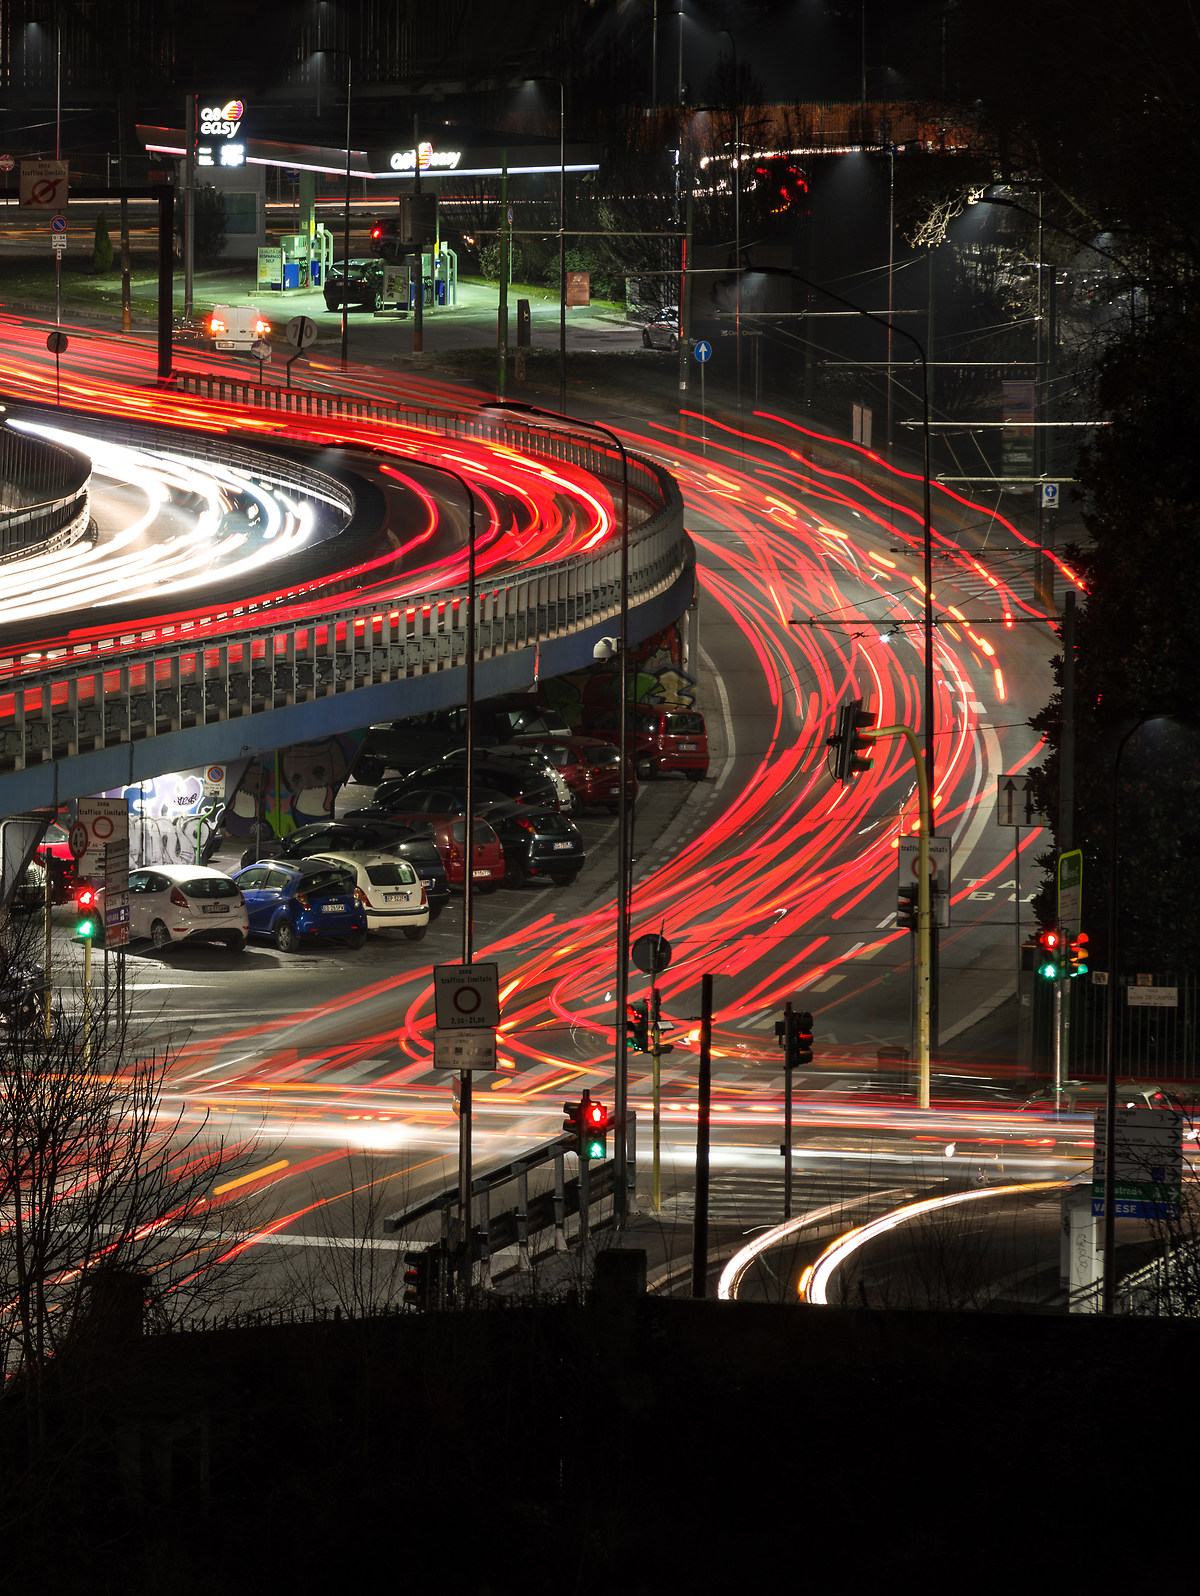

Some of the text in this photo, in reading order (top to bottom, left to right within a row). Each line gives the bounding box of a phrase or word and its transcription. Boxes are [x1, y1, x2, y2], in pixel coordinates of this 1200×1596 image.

[200, 107, 222, 122] Q8
[200, 121, 241, 139] easy
[432, 151, 461, 169] easy
[79, 808, 101, 816] traffico
[441, 975, 492, 985] traffico limitato
[1094, 1203, 1137, 1214] VAESE
